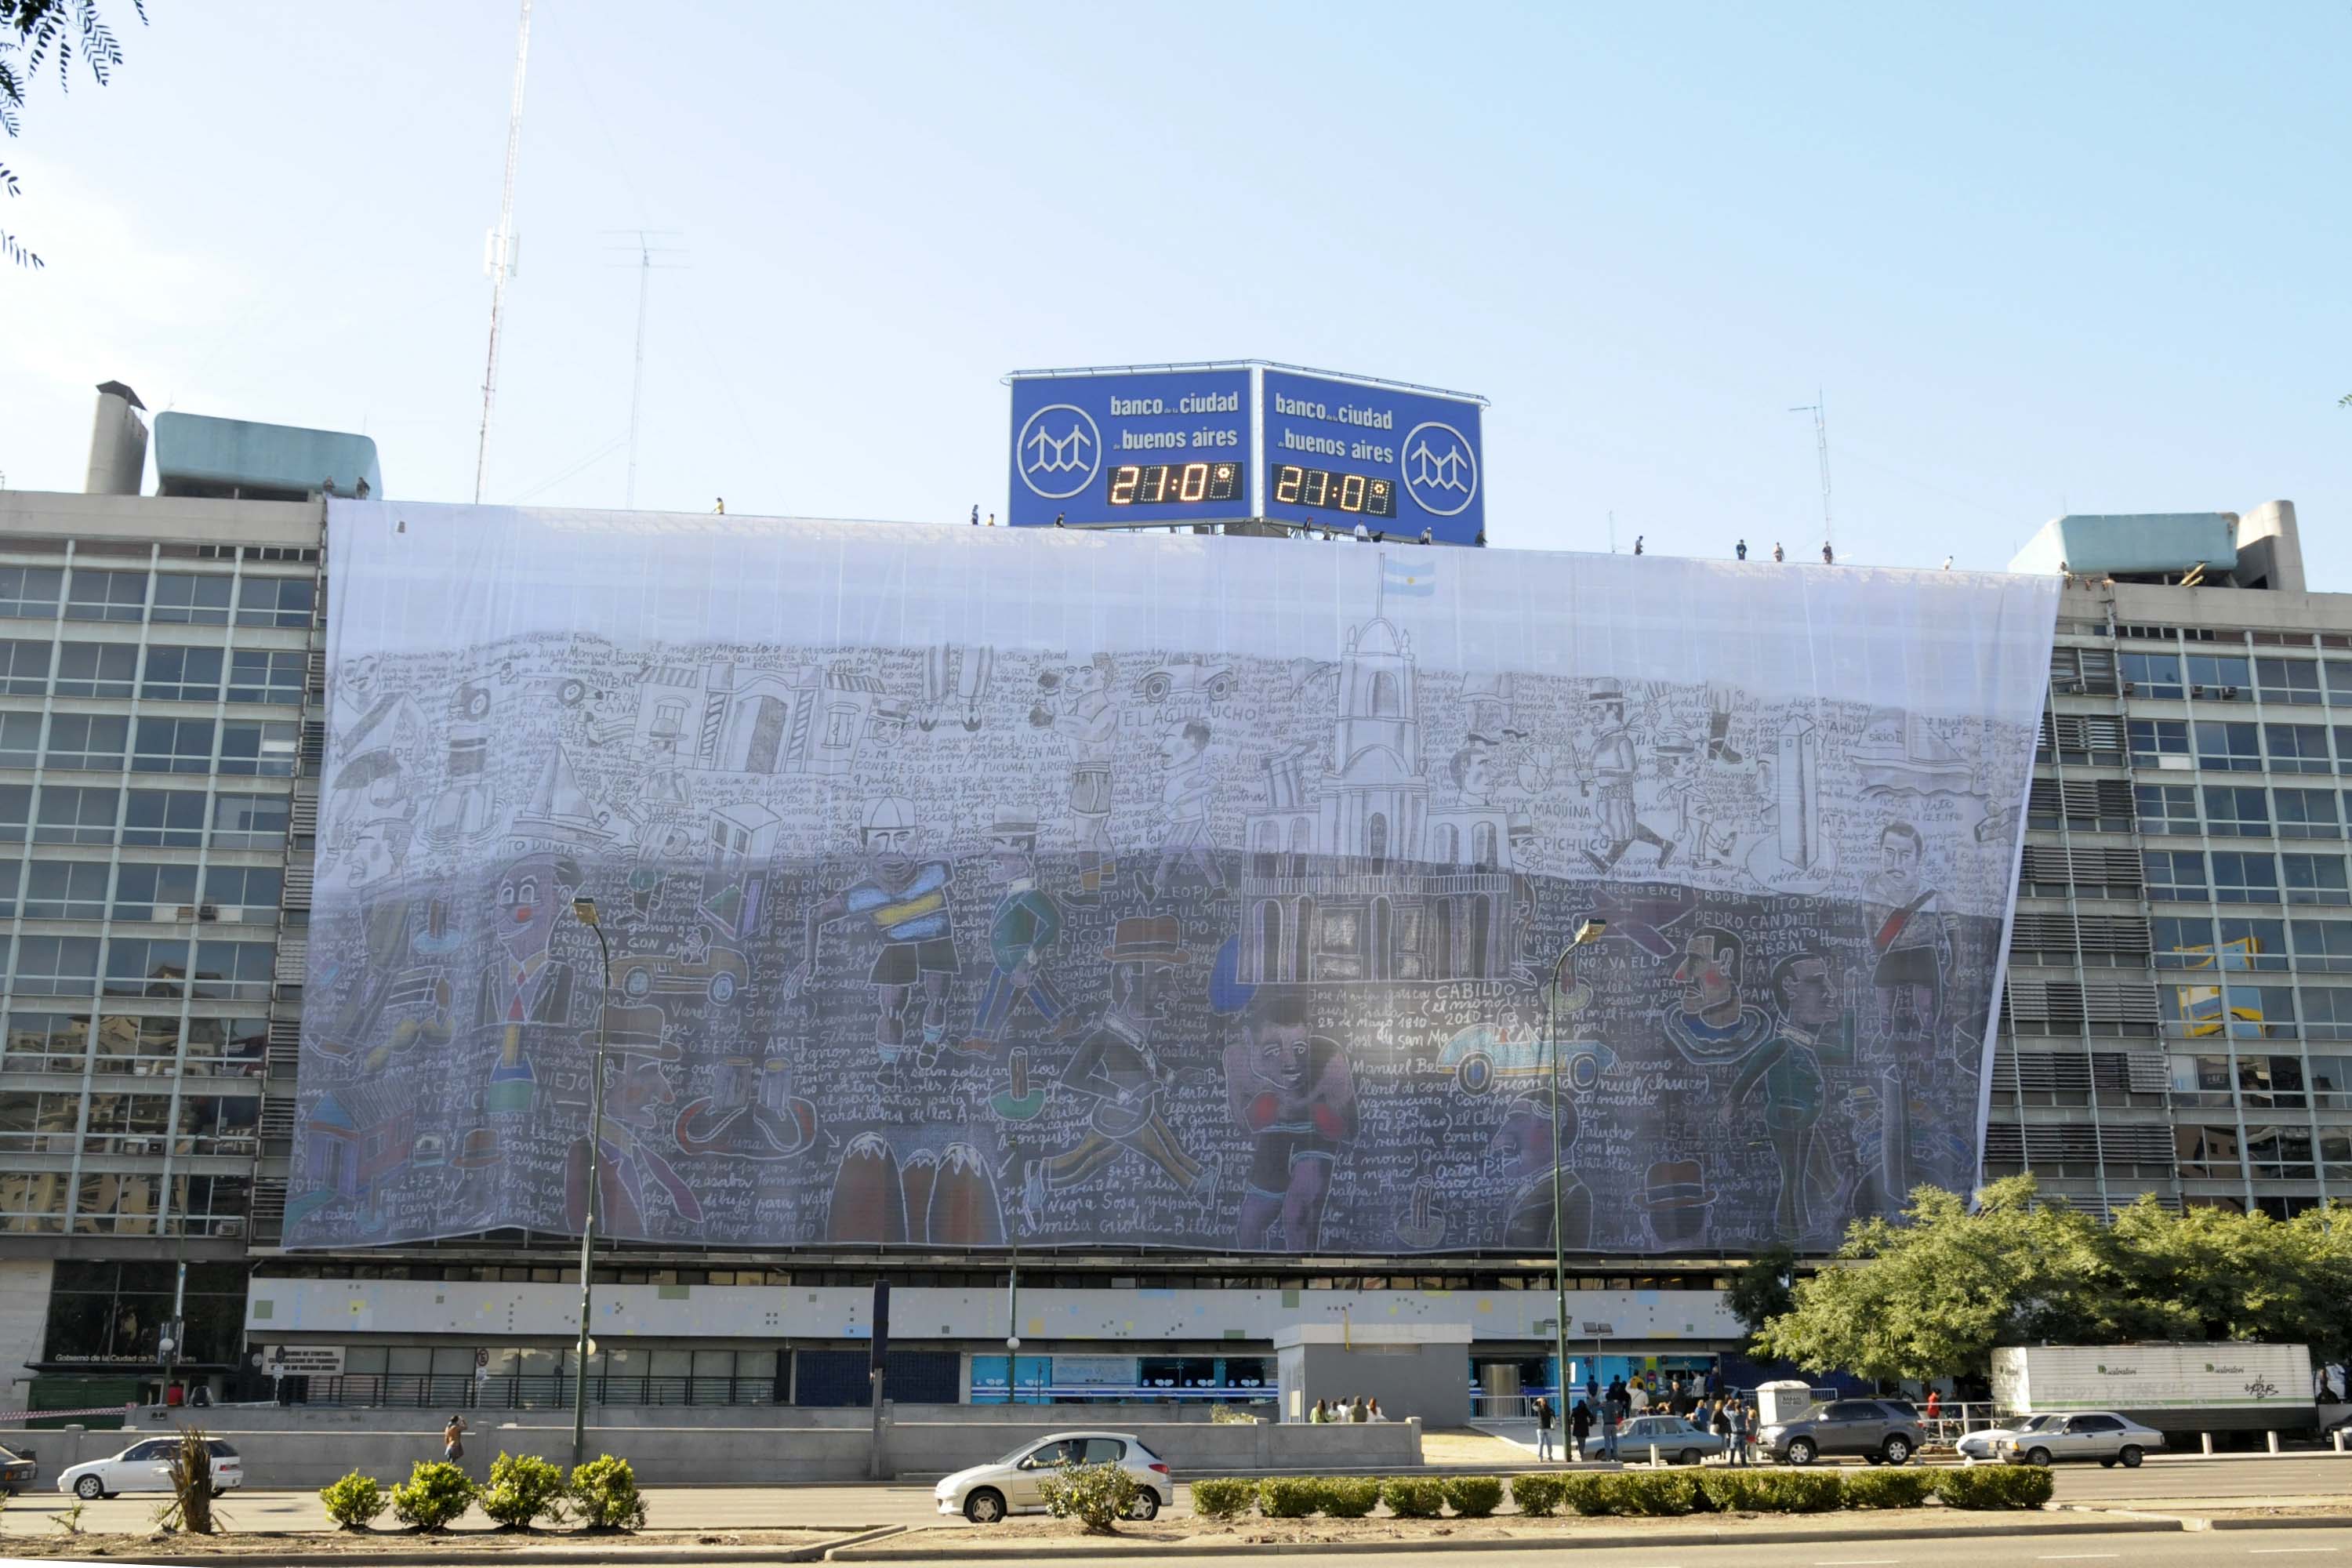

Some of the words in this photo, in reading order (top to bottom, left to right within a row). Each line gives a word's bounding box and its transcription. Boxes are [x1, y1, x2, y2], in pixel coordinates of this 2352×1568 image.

[1110, 395, 1163, 416] banco
[1180, 391, 1239, 413] ciudad
[1276, 393, 1326, 419] banco
[1338, 404, 1392, 430] ciudad
[1123, 429, 1186, 449] buenos
[1192, 426, 1237, 448] aires
[1285, 427, 1345, 456] buenos
[1352, 440, 1393, 463] aires
[1694, 910, 1744, 929] PEDRO
[1742, 927, 1817, 942] SARGENTO
[1744, 941, 1808, 956] CABRAL
[1435, 985, 1516, 1000] CABILDO
[56, 1354, 89, 1363] Gobierno
[91, 1354, 101, 1363] de
[110, 1354, 136, 1363] Ciudad
